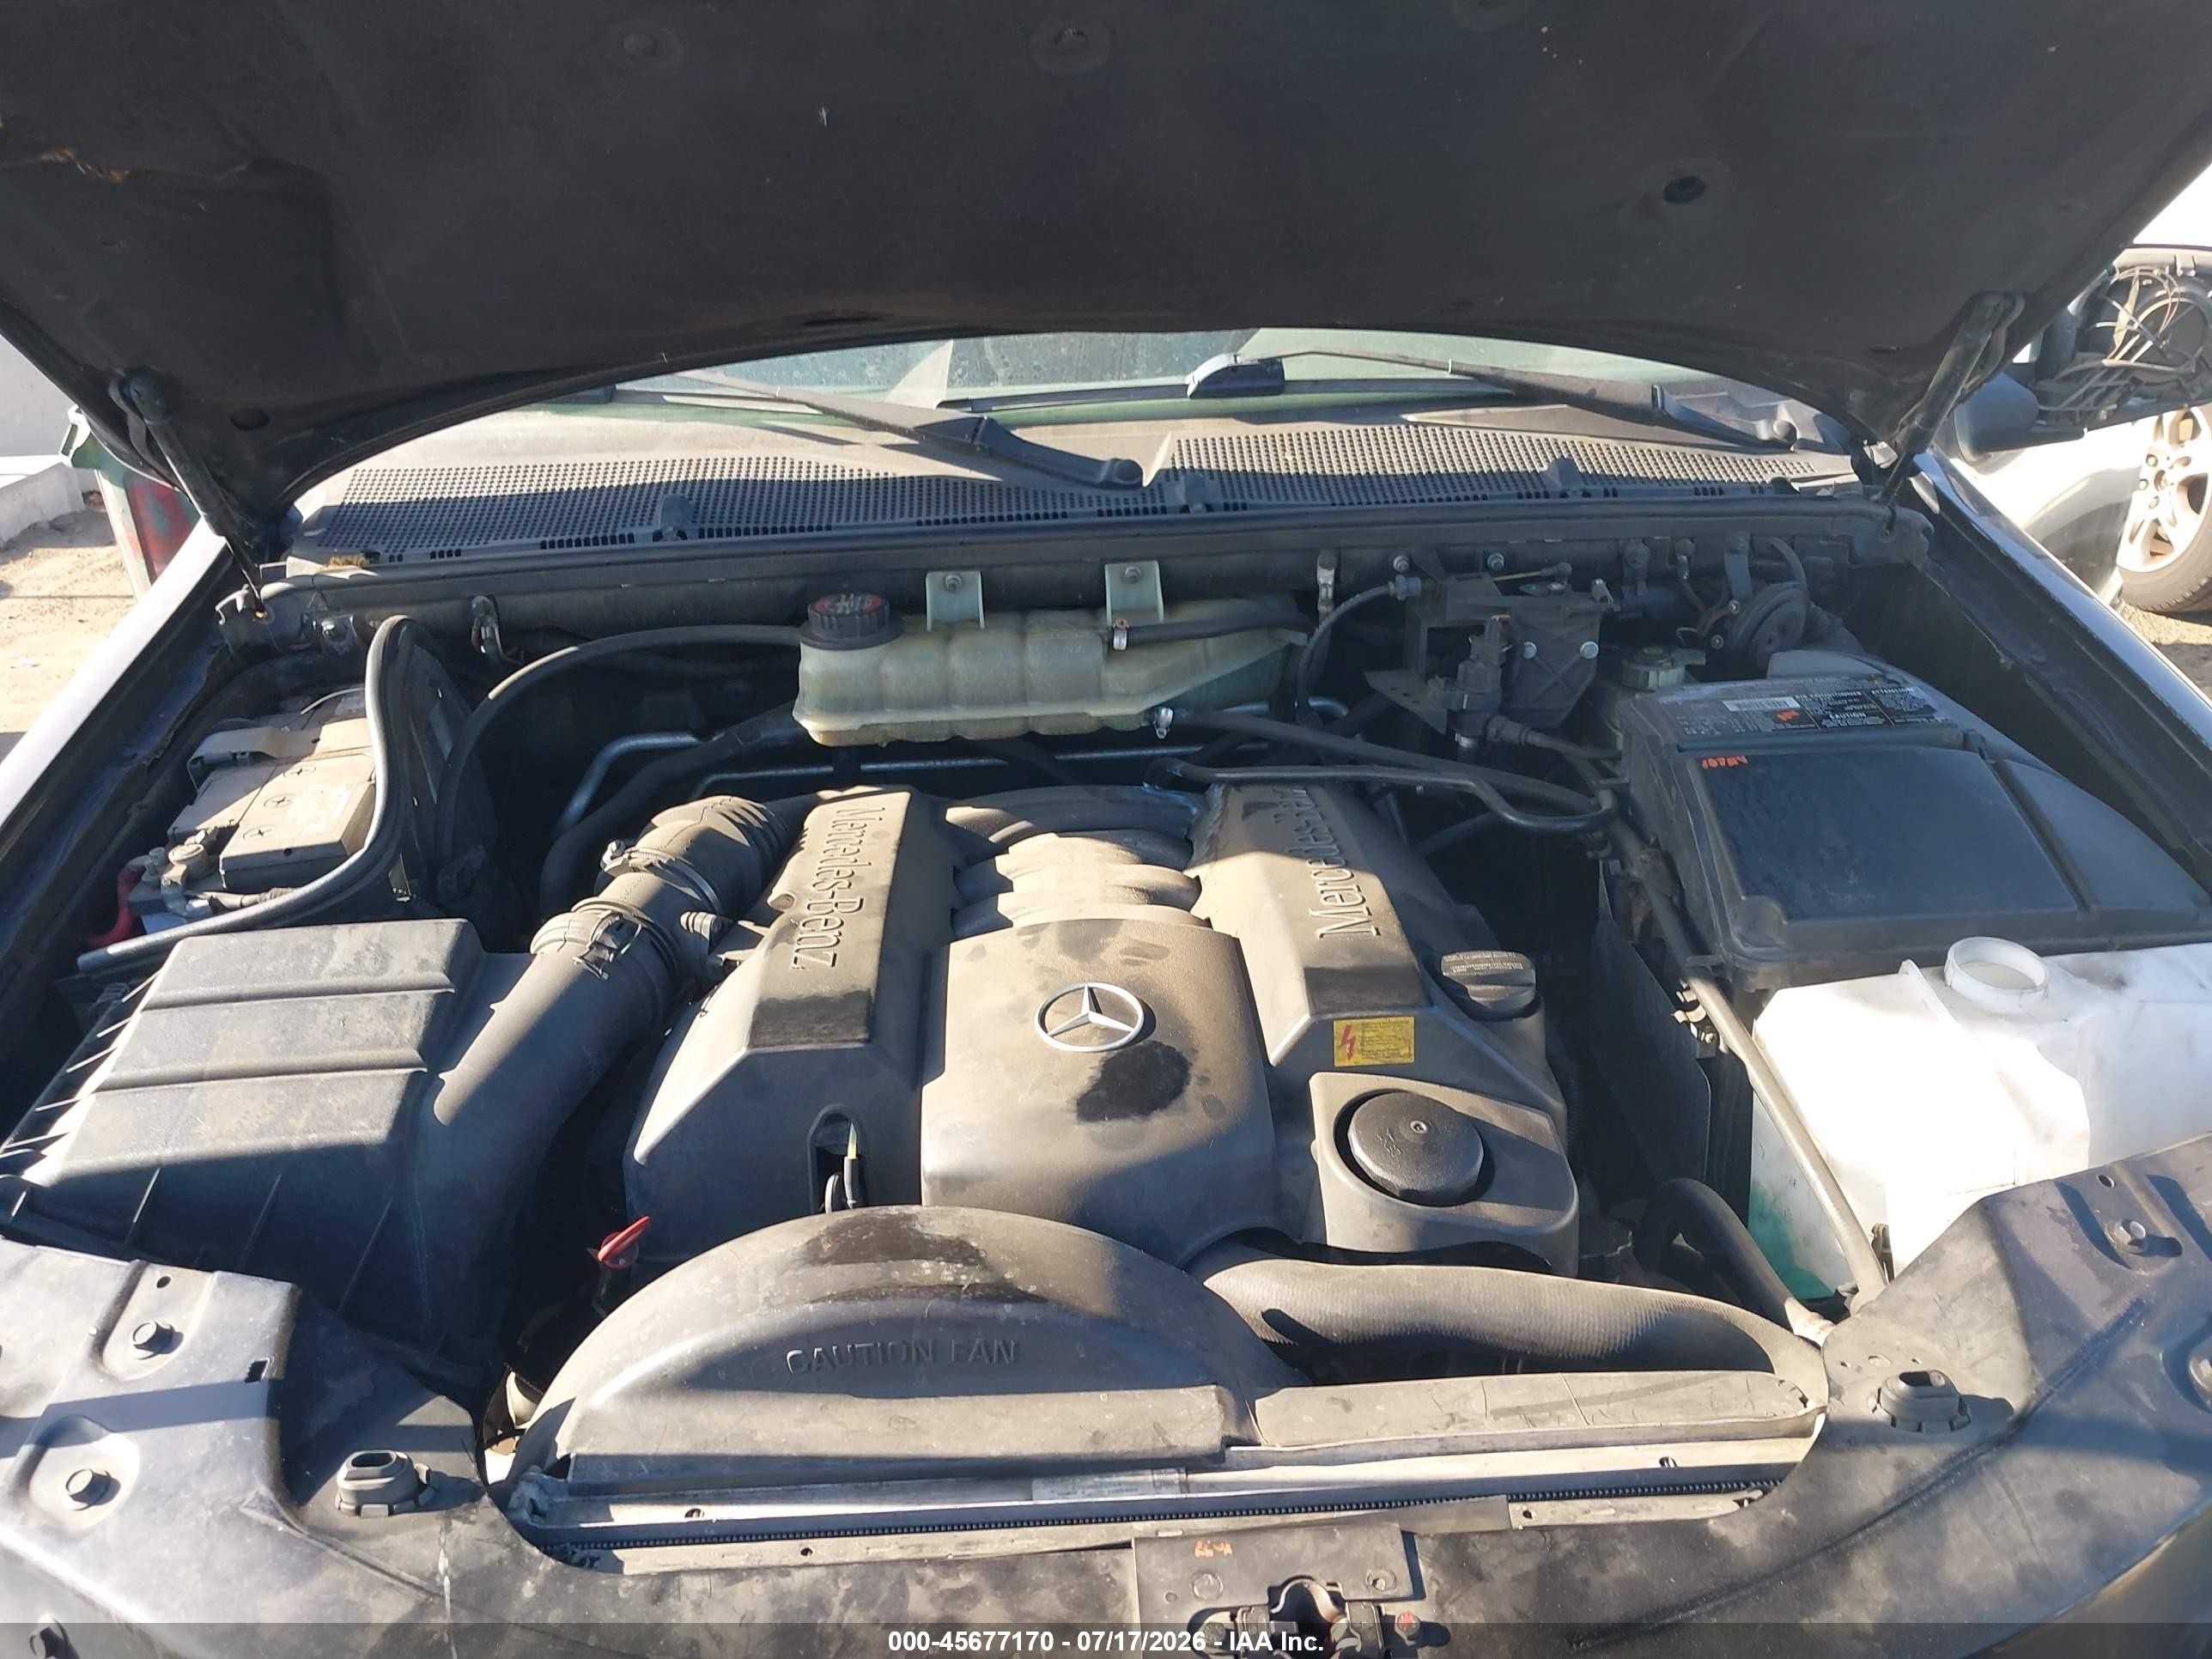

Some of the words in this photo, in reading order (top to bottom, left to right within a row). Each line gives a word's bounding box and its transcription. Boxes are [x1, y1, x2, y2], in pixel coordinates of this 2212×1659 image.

[790, 806, 886, 971] Mercedes-Benz
[785, 1339, 934, 1374] CAUTION
[951, 1337, 1017, 1364] FAN
